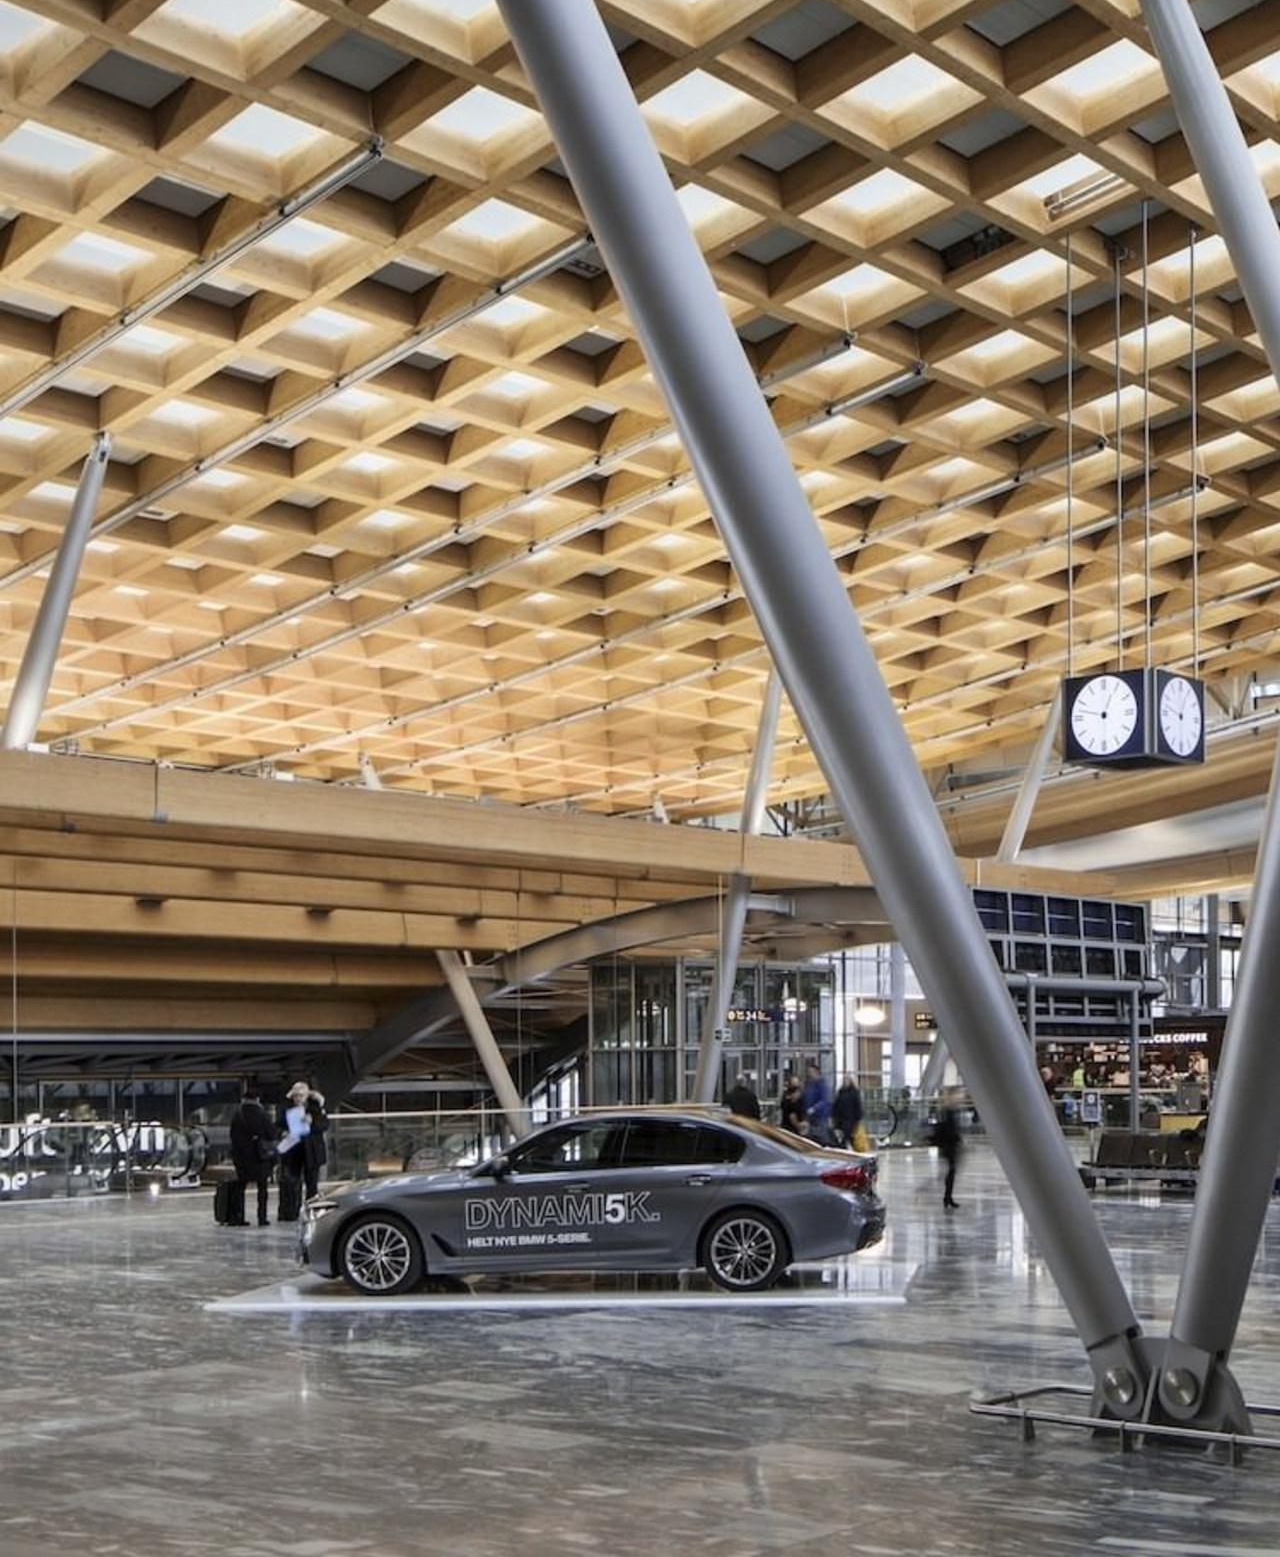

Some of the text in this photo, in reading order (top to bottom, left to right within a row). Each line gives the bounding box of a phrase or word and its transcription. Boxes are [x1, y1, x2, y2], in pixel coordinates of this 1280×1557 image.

[1172, 1032, 1208, 1043] COFFEE
[466, 1191, 661, 1230] DYNAMI5K.
[467, 1236, 494, 1248] HELT
[494, 1235, 517, 1246] NYE
[519, 1233, 546, 1245] BMW
